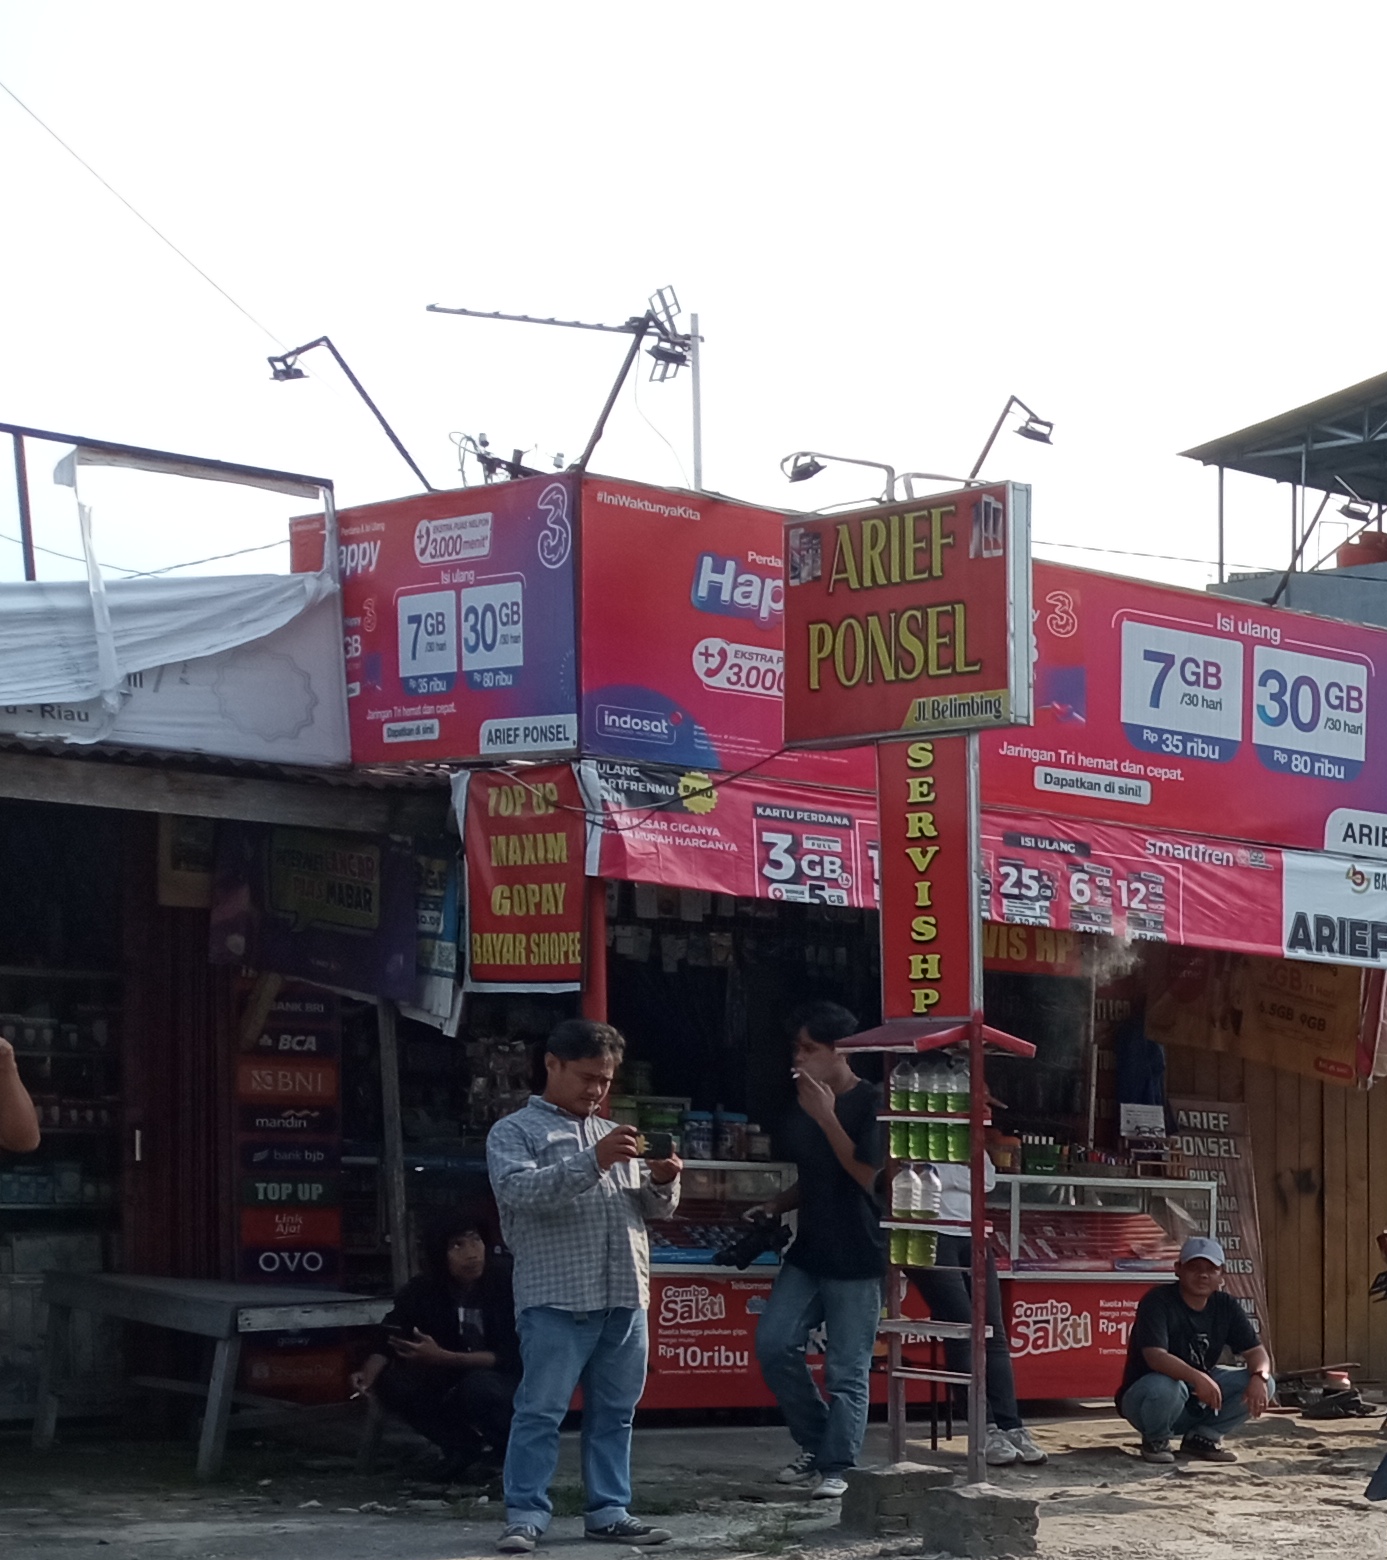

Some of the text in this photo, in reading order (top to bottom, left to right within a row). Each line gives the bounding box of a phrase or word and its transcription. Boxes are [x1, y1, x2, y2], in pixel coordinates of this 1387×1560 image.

[596, 491, 700, 521] #IniWaktunyaKita
[829, 505, 956, 593] ARIEF
[407, 612, 446, 661] 7 GB
[463, 601, 521, 654] 30 GB
[1216, 613, 1281, 645] Isi ulang
[733, 649, 775, 665] EKSTRA
[808, 603, 981, 690] PONSEL
[495, 671, 513, 686] ribu
[1143, 649, 1223, 709] 7 GB
[931, 694, 1003, 720] Belimbing
[1179, 693, 1223, 711] /30 hari
[1256, 668, 1364, 732] 30 GB
[486, 724, 570, 747] ARIEF PONSEL
[604, 711, 669, 734] indosat
[1323, 716, 1363, 735] /30 hari
[1142, 729, 1220, 760] Rp 35 ribu
[998, 741, 1184, 782] Jaringan Tri hemat dan cepat.
[1273, 750, 1345, 779] Rp 80 ribu
[1043, 772, 1142, 798] Dapatkan di sini!
[488, 785, 526, 817] TOP
[669, 823, 721, 837] GIGANYA
[756, 806, 850, 827] KARTU PERDANA
[490, 832, 568, 867] MAXIM
[675, 837, 738, 852] HARGANYA
[905, 741, 940, 942] SERVIS
[1020, 836, 1076, 854] ISI ULANG
[1145, 839, 1234, 866] smartfren
[762, 832, 842, 880] 3 GB
[998, 865, 1040, 897] 25
[1069, 872, 1091, 904] 6
[1116, 879, 1147, 910] 12
[490, 883, 567, 916] GOPAY
[828, 894, 845, 905] GB
[472, 931, 582, 965] BAYAR SHOPEE
[277, 1035, 318, 1052] BCA
[276, 1072, 323, 1092] BNI
[1177, 1110, 1229, 1132] ARIEF
[273, 1149, 324, 1163] bank bjb
[255, 1183, 323, 1201] TOP UP
[274, 1214, 303, 1225] Link
[258, 1252, 323, 1272] OVO
[662, 1286, 709, 1300] Combo
[660, 1295, 725, 1325] Sakti
[1013, 1300, 1071, 1320] Combo
[1010, 1312, 1092, 1358] Sakti
